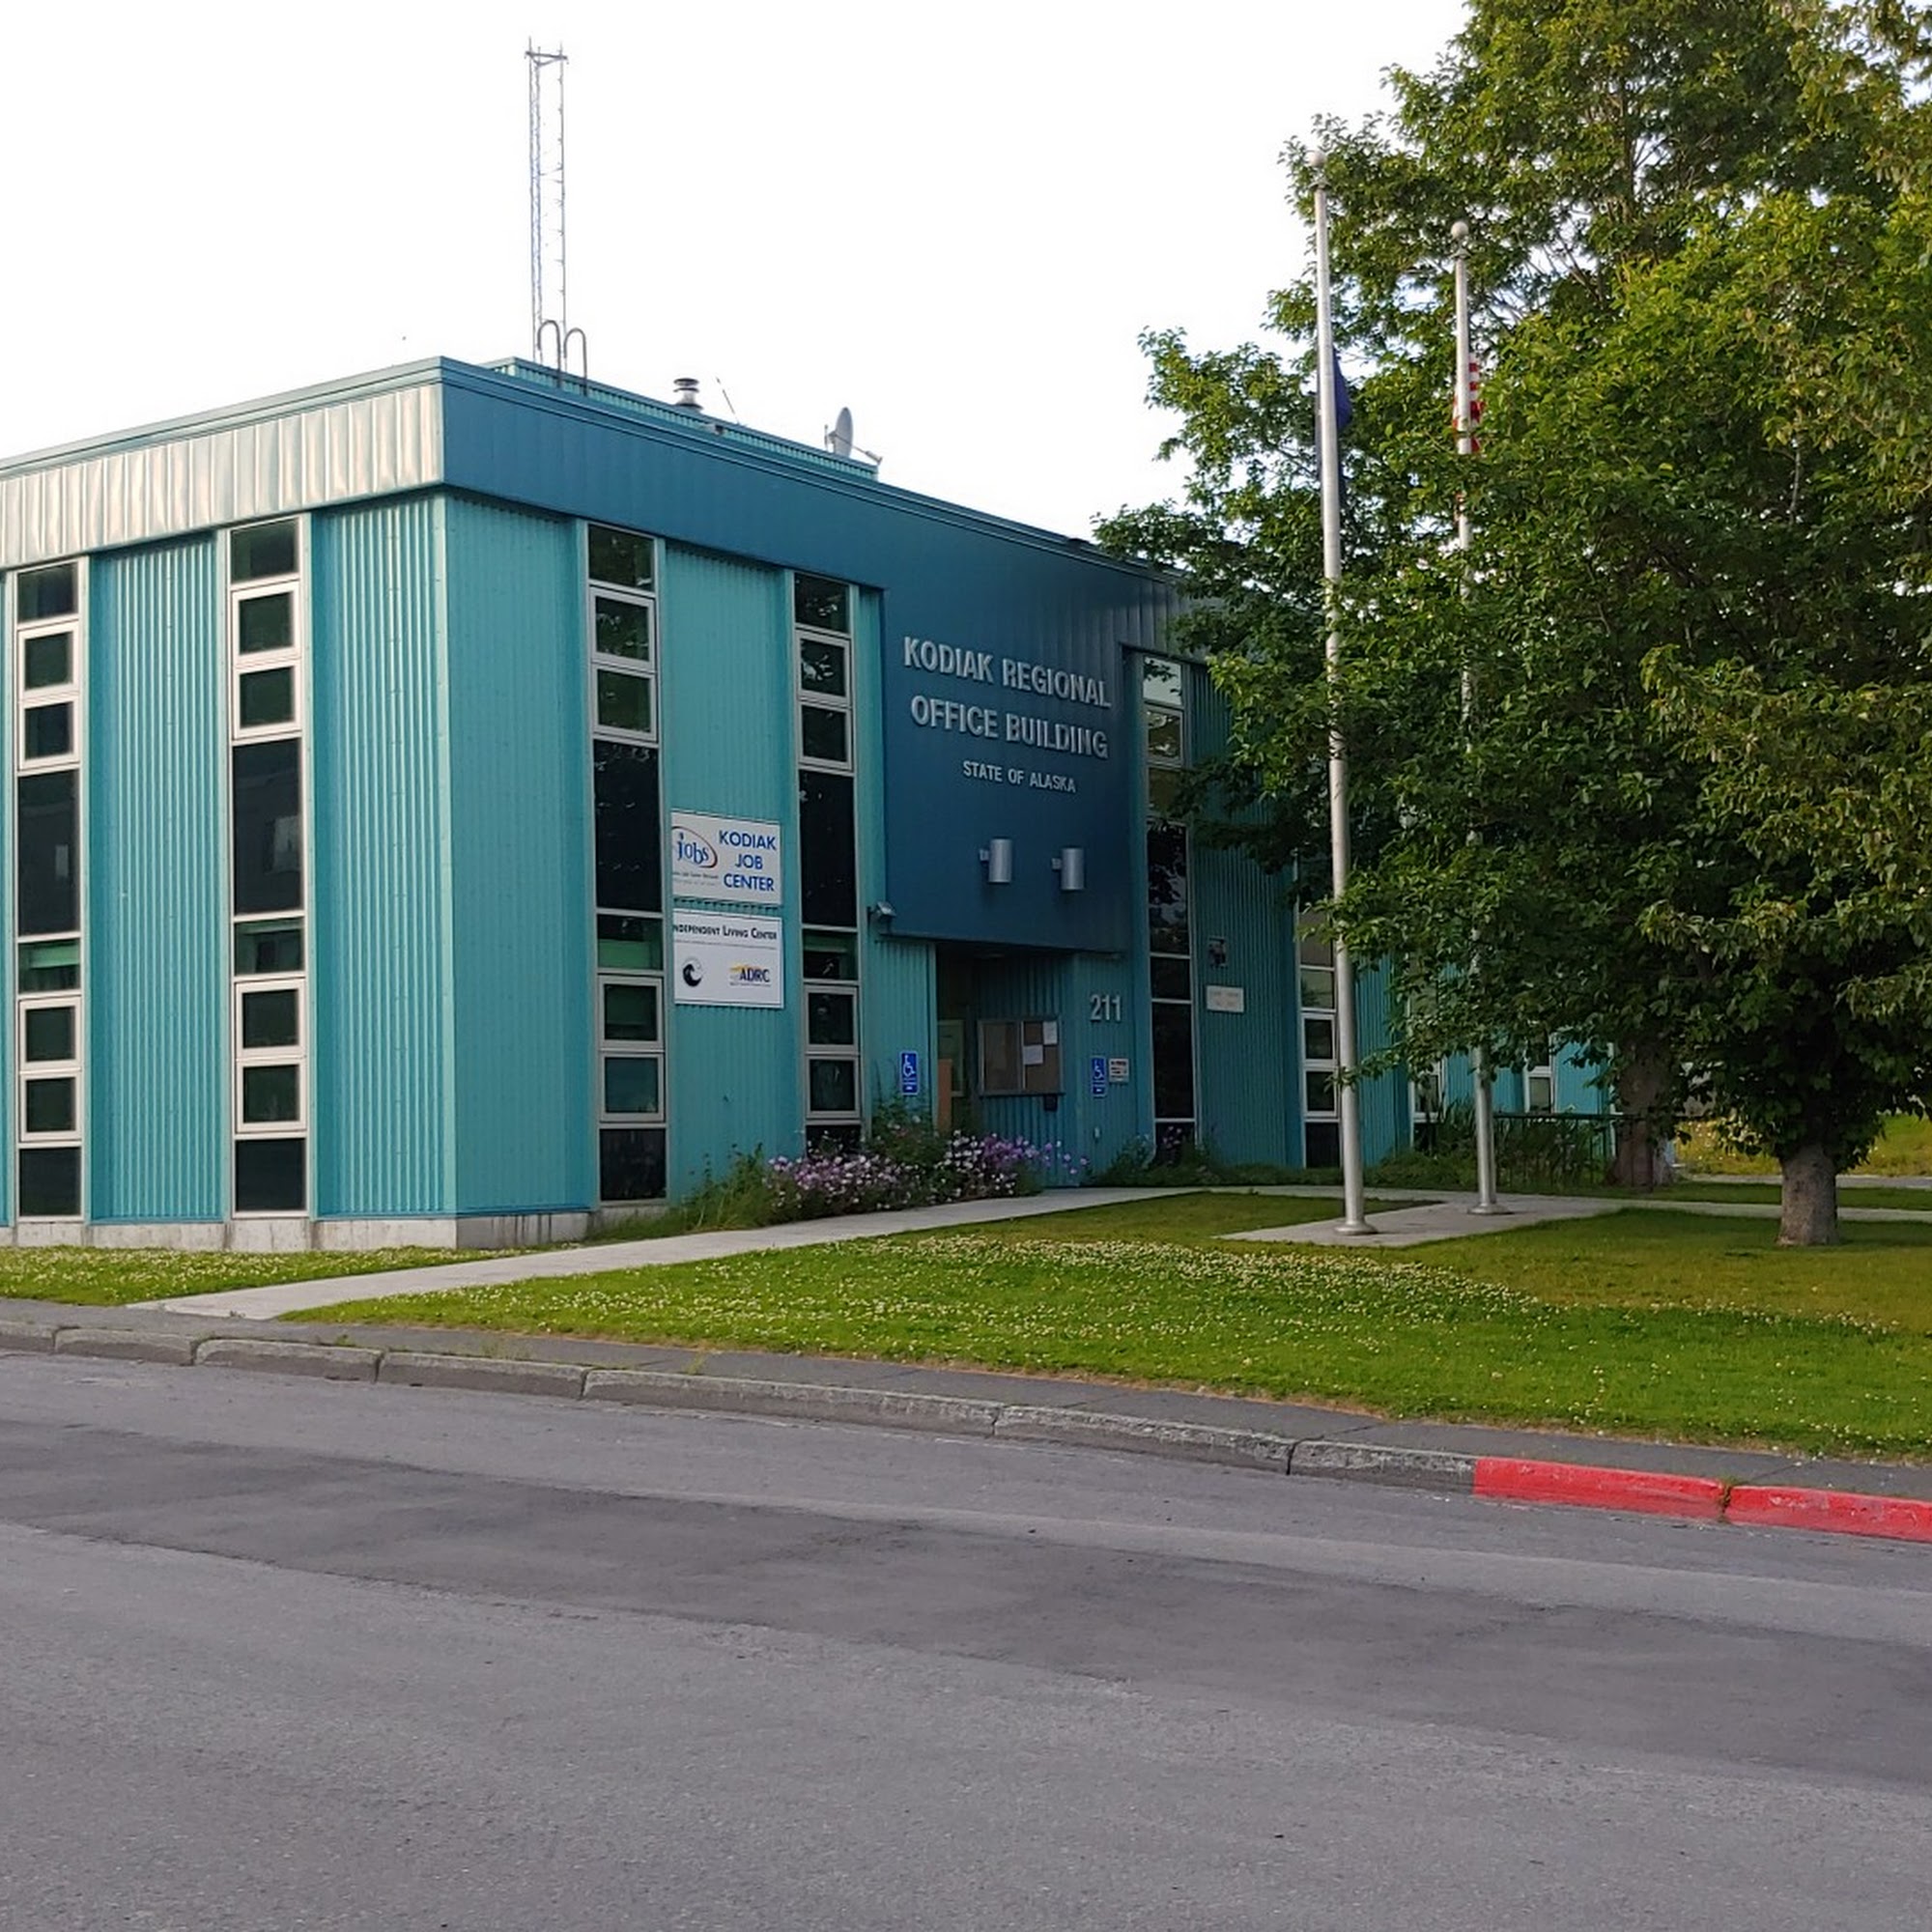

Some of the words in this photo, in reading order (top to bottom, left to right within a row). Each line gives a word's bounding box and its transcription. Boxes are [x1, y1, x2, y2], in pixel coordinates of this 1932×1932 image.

[903, 636, 994, 684] KODIAK
[1002, 658, 1112, 709] REGIONAL
[911, 695, 998, 739] OFFICE
[1006, 713, 1109, 759] BUILDING
[962, 760, 1003, 782] STATE
[1008, 769, 1025, 785] OF
[1029, 772, 1077, 793] ALASKA
[676, 832, 709, 865] jobs
[719, 830, 777, 851] KODIAK
[734, 853, 763, 869] JOB
[724, 872, 775, 892] CENTER
[739, 967, 771, 983] ADRC
[1089, 994, 1122, 1022] 211
